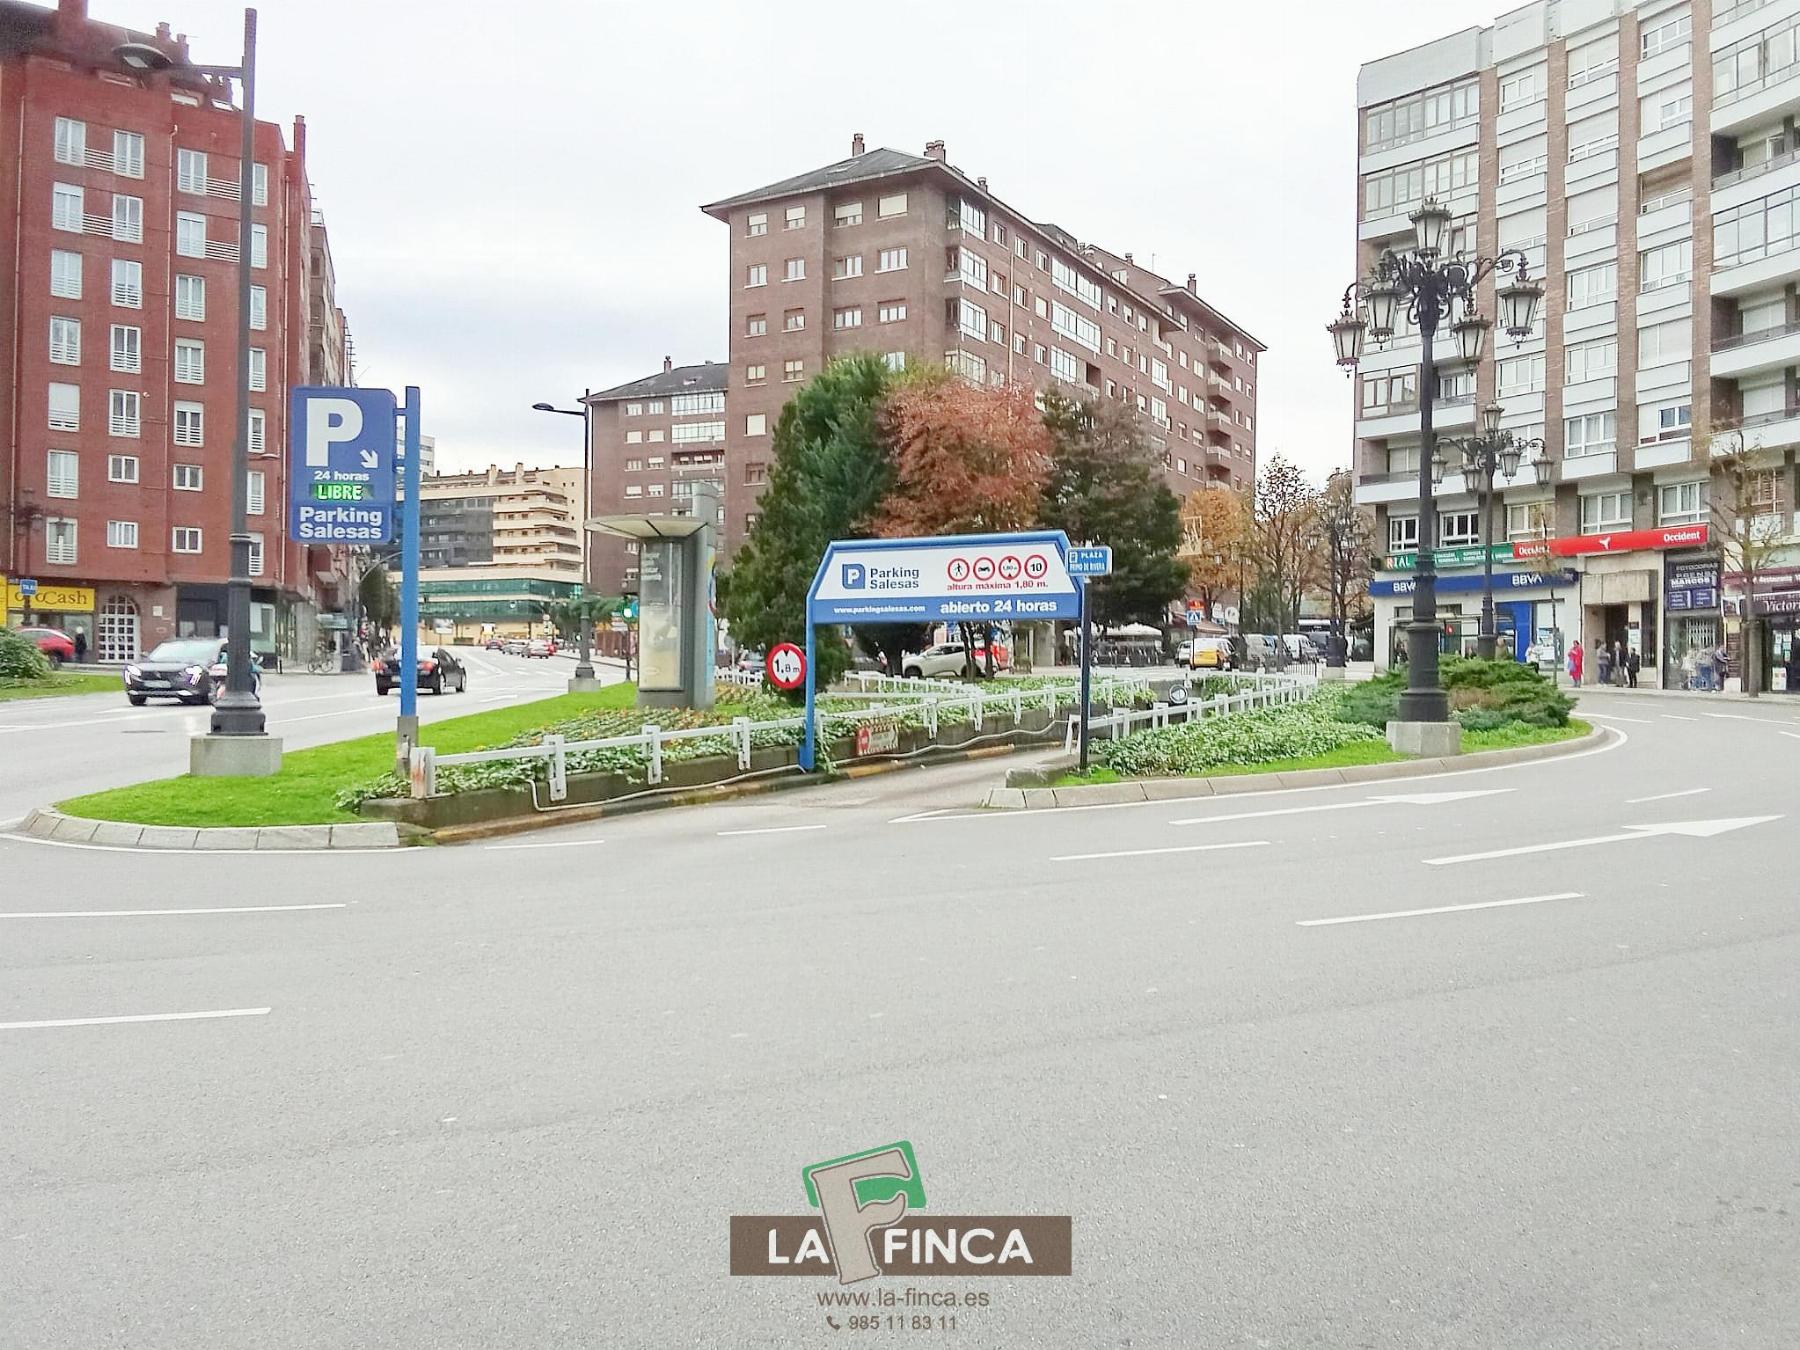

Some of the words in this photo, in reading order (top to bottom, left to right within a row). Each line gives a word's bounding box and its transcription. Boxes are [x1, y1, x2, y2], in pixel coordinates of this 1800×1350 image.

[305, 398, 363, 467] P
[313, 470, 331, 481] 24
[333, 471, 370, 481] horas
[317, 484, 362, 500] LIBRE
[299, 506, 383, 526] Parking
[299, 522, 382, 539] Salesas
[1663, 531, 1701, 543] Occident
[1080, 551, 1104, 559] PLAZA
[870, 567, 920, 580] Parking
[1030, 562, 1043, 572] 10
[870, 579, 920, 590] Salesas
[946, 583, 973, 591] altura
[1014, 580, 1034, 589] 1,80
[1512, 572, 1543, 586] BBVA
[15, 591, 87, 604] ooCash
[833, 605, 926, 615] www.parkingsalesas.com
[940, 601, 990, 614] abierto
[994, 600, 1012, 612] 24
[1016, 599, 1057, 612] horas
